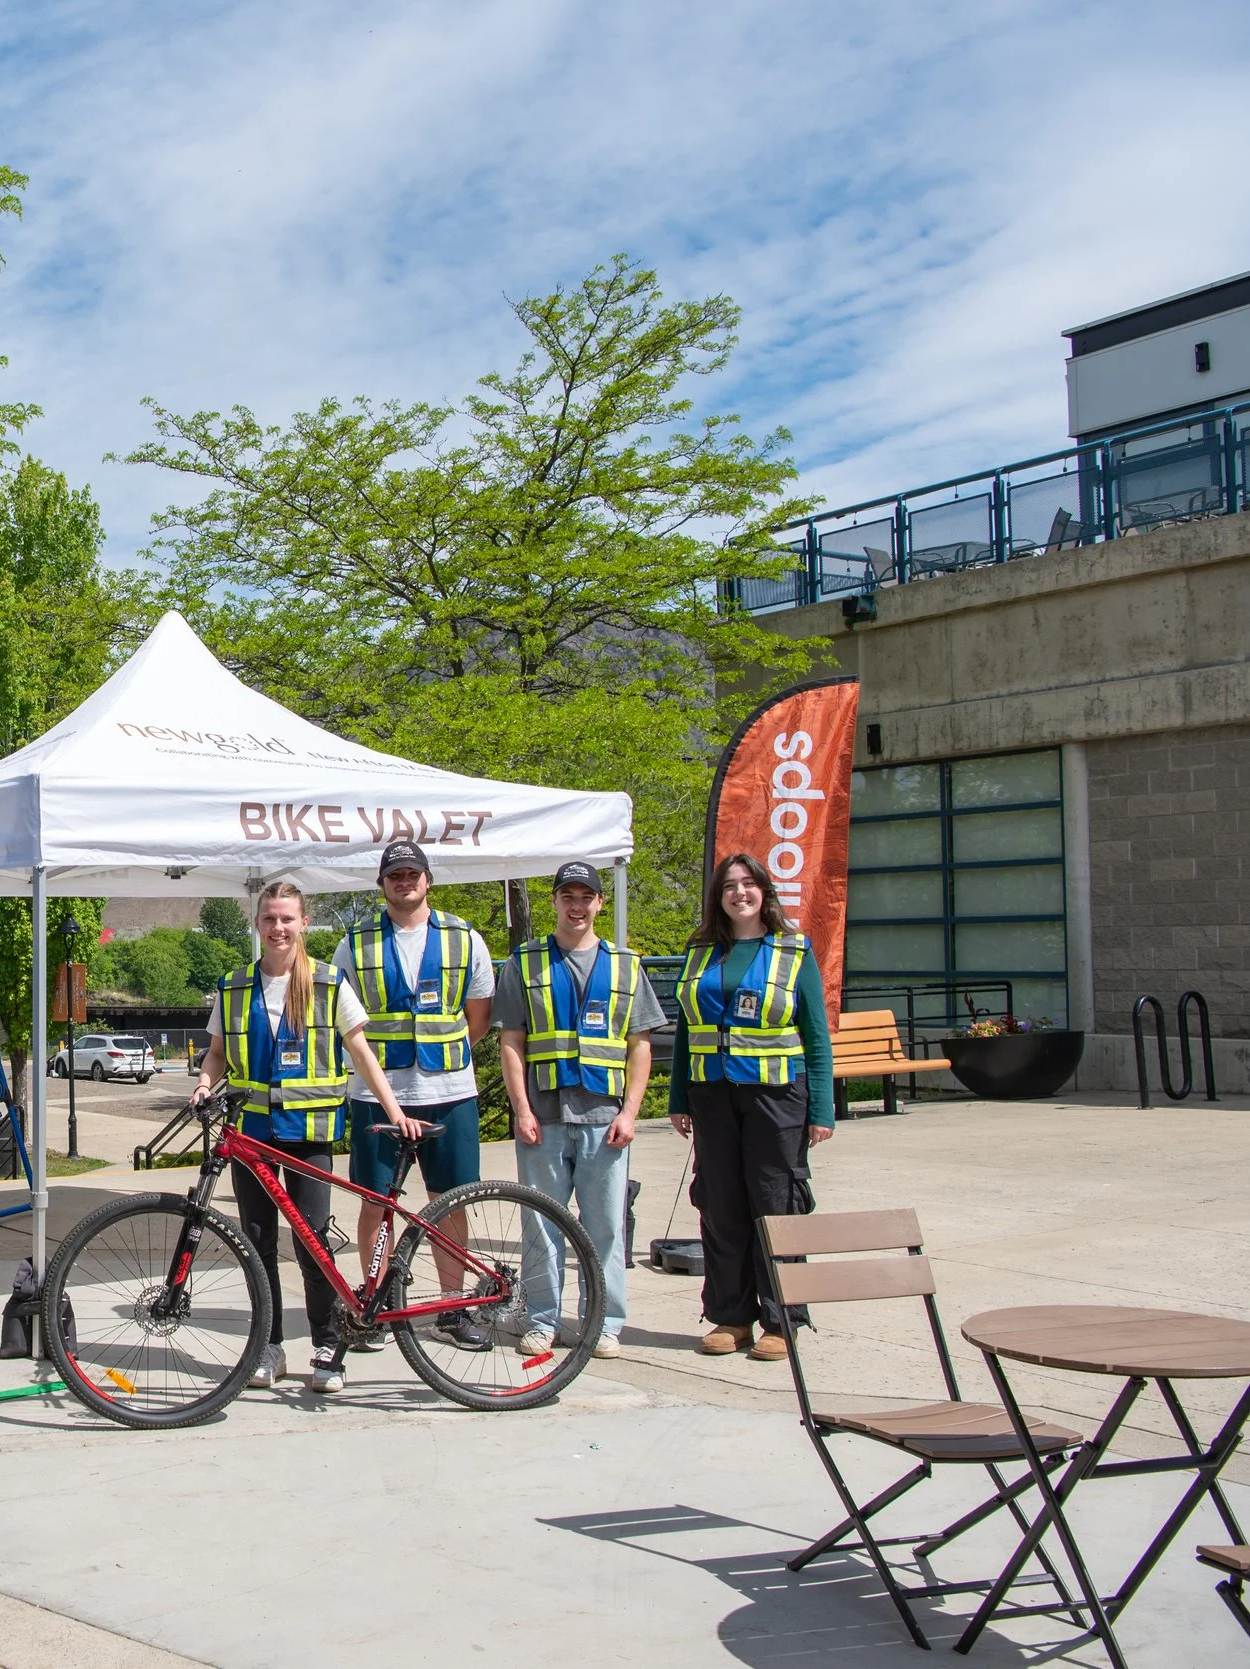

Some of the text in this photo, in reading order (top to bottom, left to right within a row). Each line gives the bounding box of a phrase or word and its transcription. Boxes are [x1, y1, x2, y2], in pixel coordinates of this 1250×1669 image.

[239, 801, 493, 847] BIKE VALET
[254, 1162, 331, 1263] ROCKY MOUNTAIN
[449, 1188, 501, 1208] MAXXIS
[207, 1215, 250, 1258] MAXXIS
